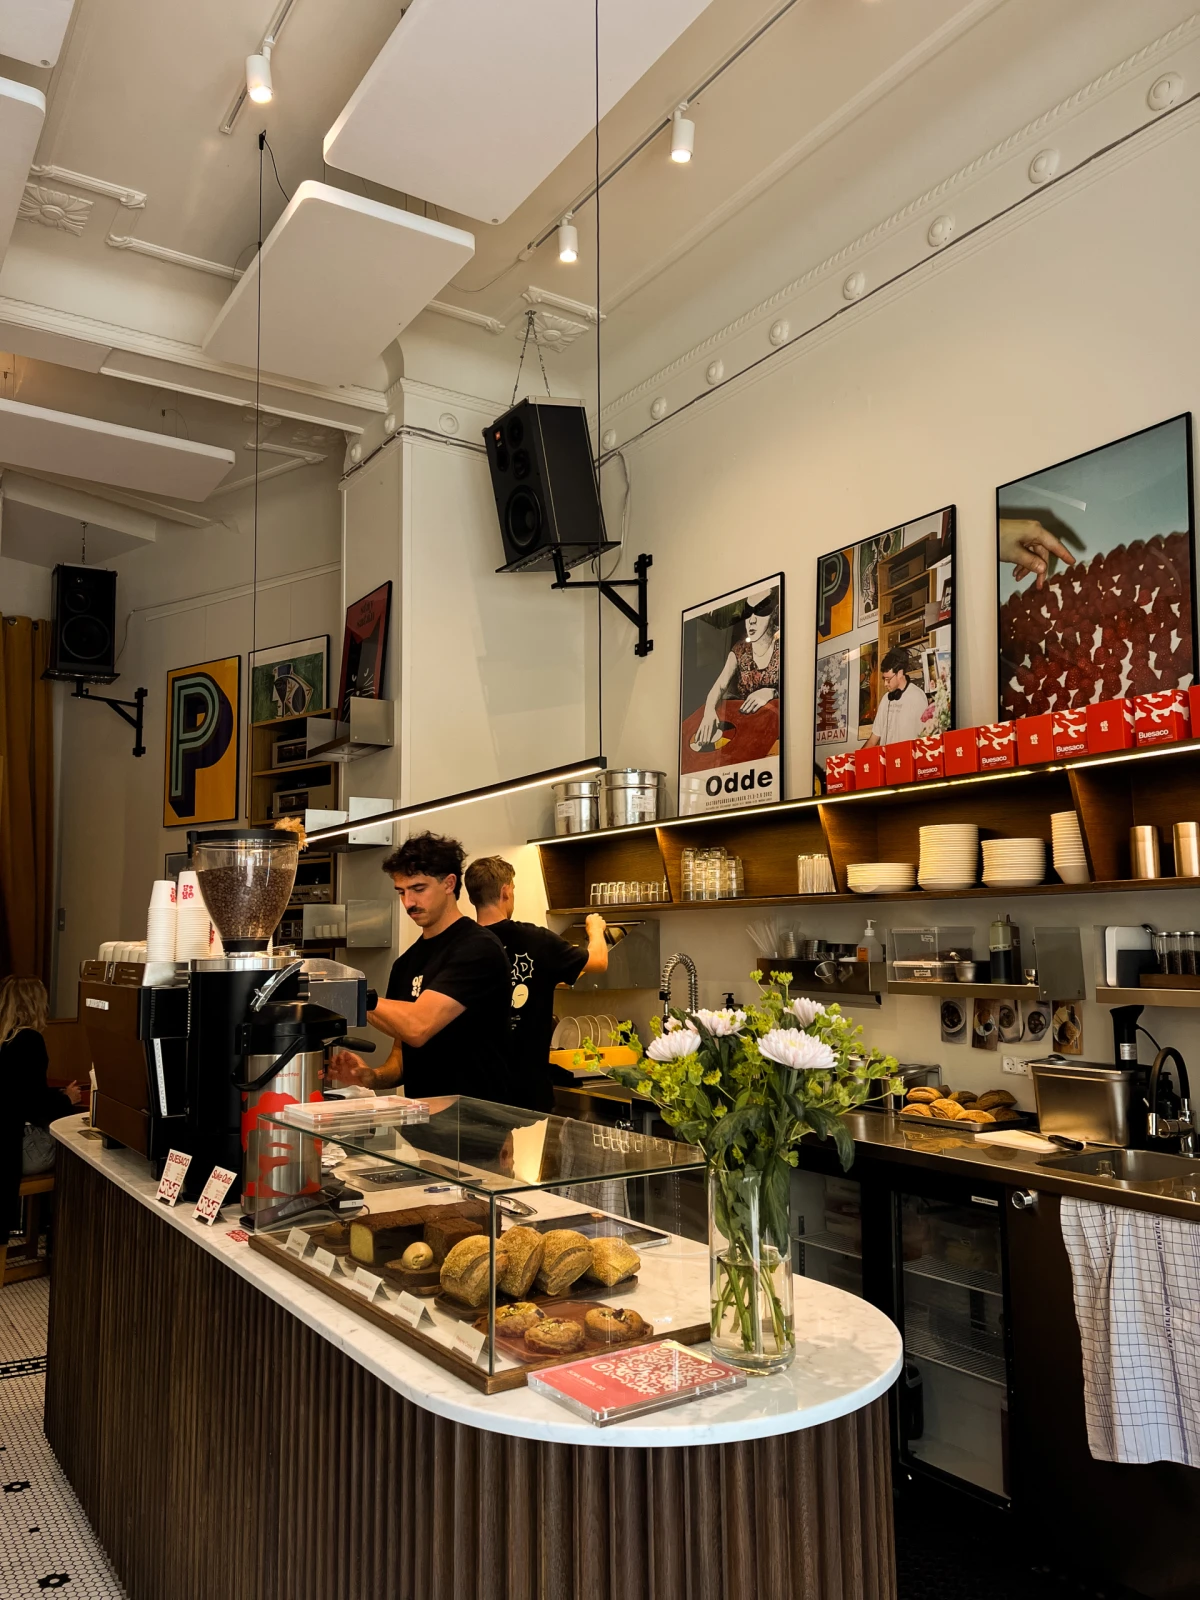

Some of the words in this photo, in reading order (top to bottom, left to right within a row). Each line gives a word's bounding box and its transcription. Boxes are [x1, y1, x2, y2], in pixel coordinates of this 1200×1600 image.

[816, 729, 846, 741] JAPAN
[1138, 728, 1169, 739] Buesaco
[1056, 743, 1085, 753] Buesaco
[981, 755, 1007, 764] Buesaco
[917, 766, 938, 775] Buesaco
[705, 769, 773, 797] Odde
[168, 1152, 190, 1167] BUESACO
[1164, 1305, 1174, 1348] TEXTILIA
